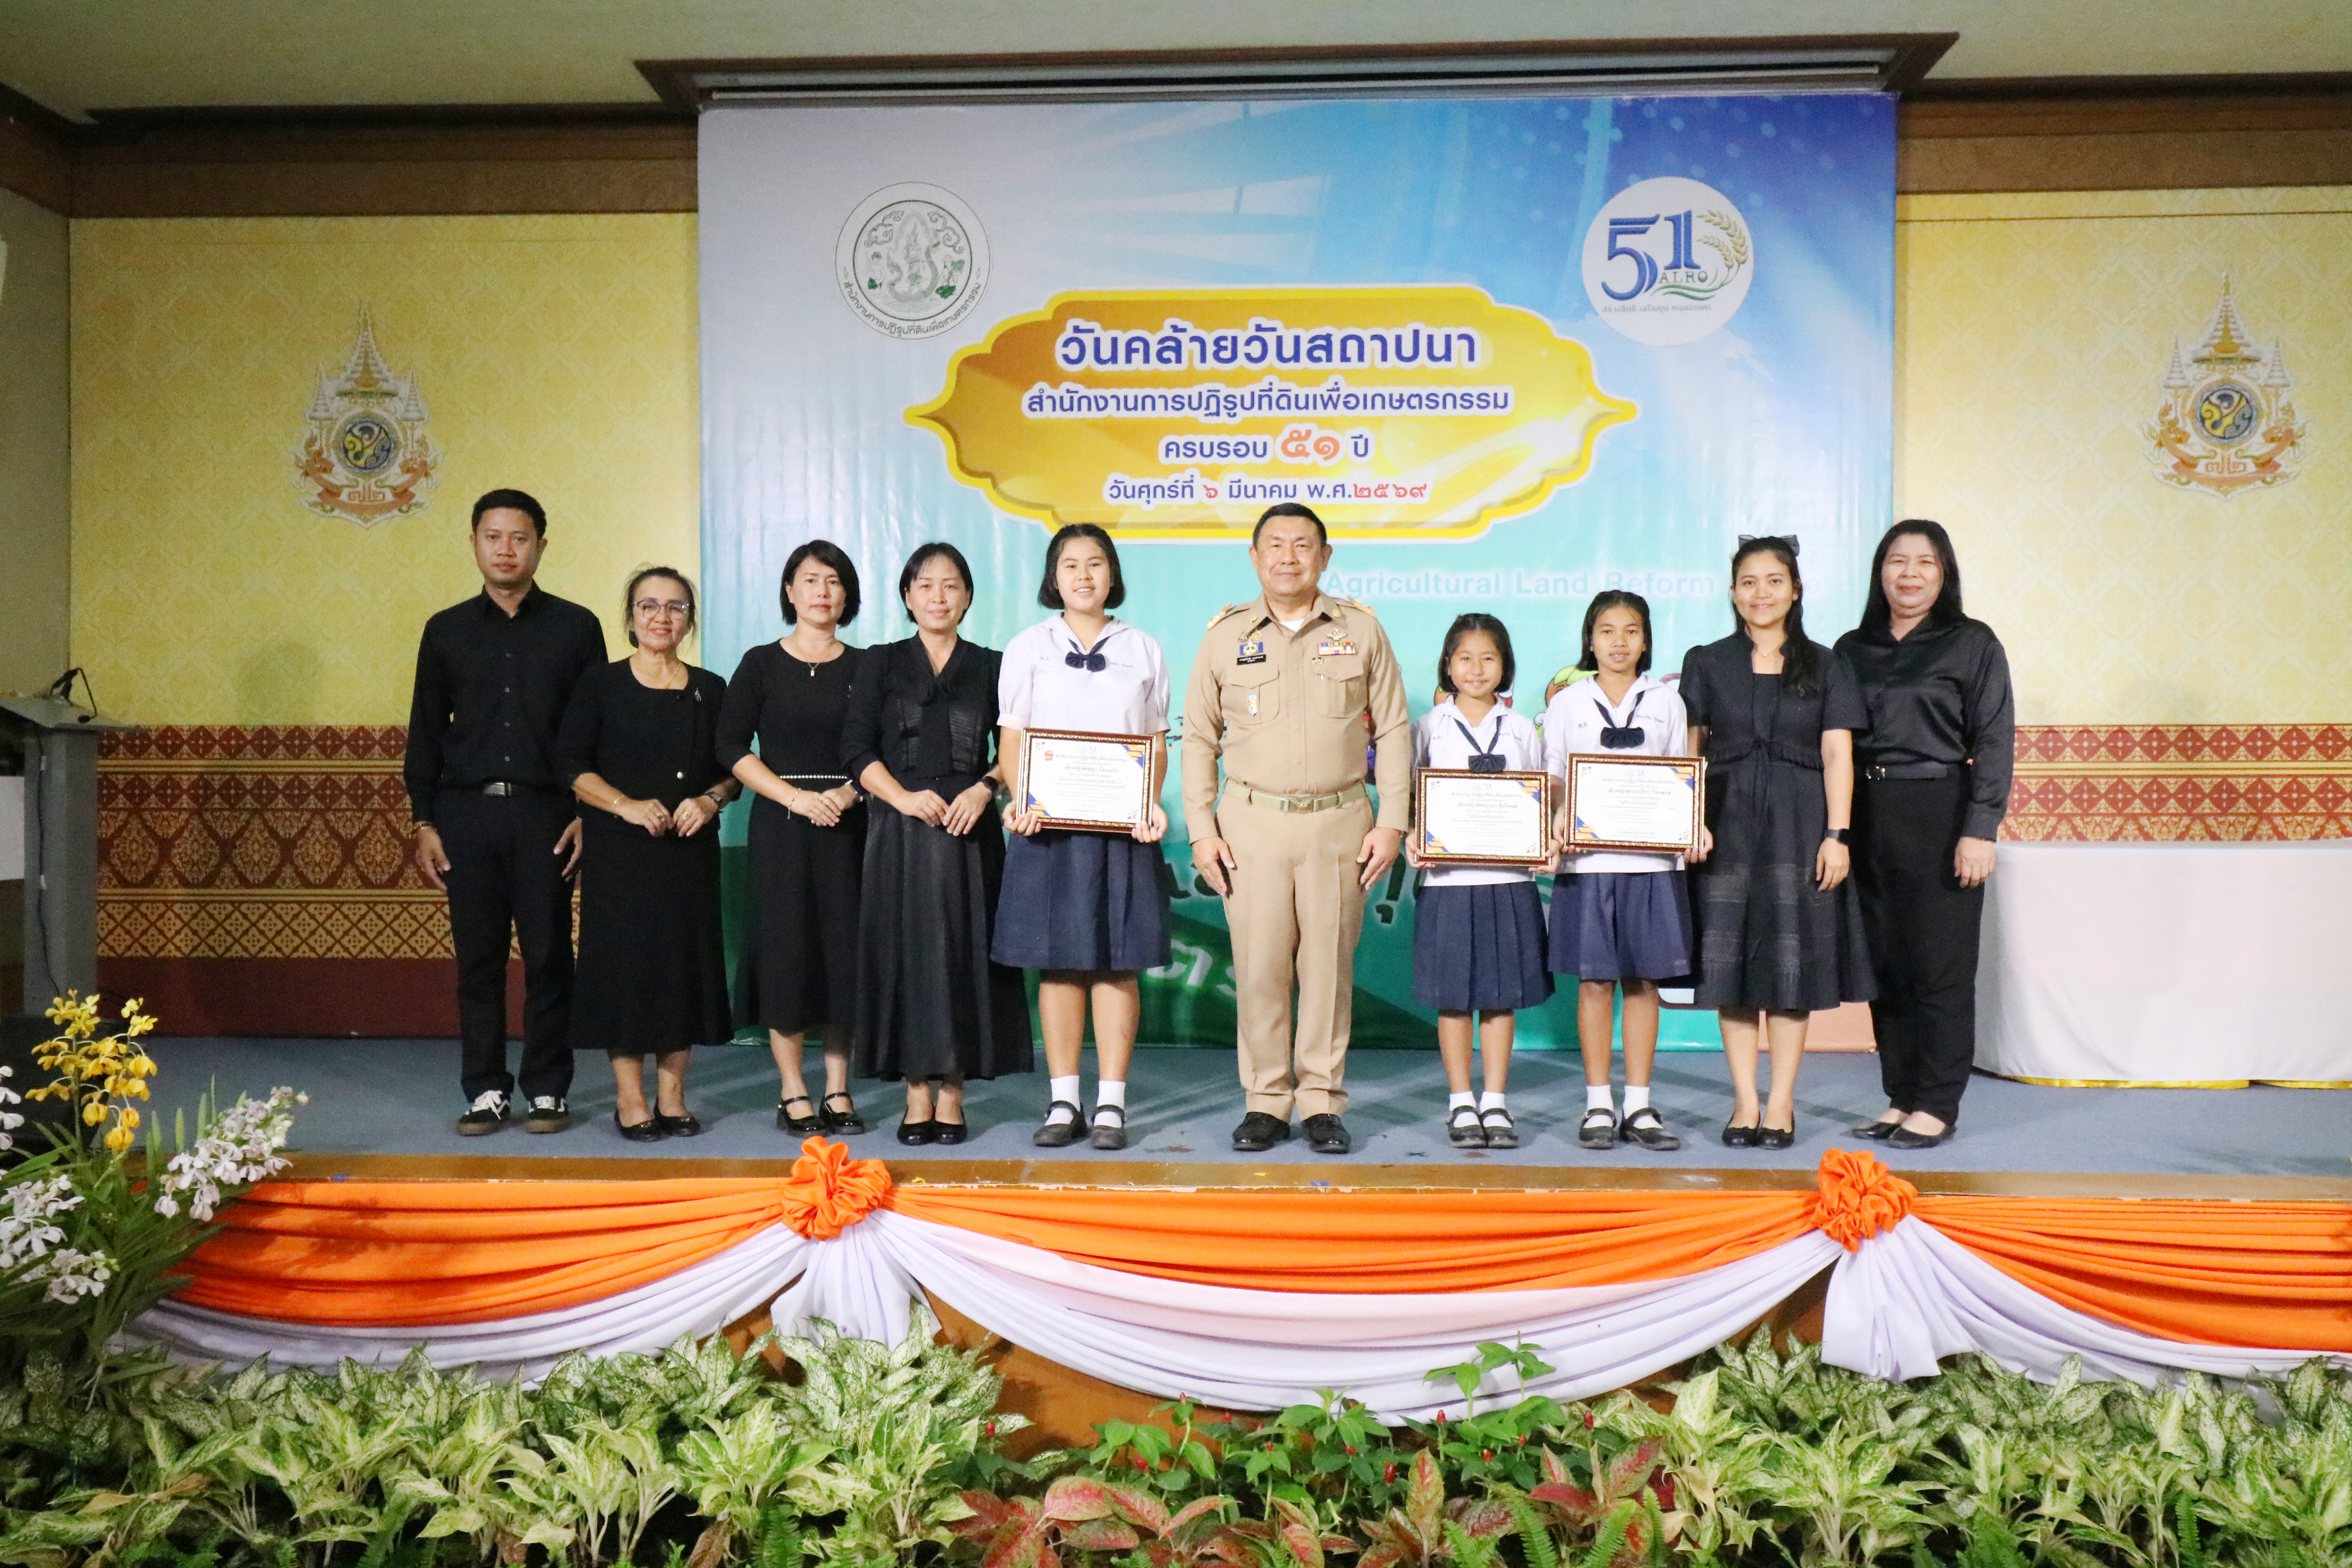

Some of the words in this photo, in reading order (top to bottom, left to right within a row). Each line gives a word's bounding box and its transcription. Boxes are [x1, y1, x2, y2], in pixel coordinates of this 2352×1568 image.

[1600, 209, 1701, 301] 51
[1659, 270, 1709, 285] ALRO
[1062, 322, 1476, 365] วันคล้ายวันสถาปนา
[1028, 381, 1509, 418] สำนักงานการปฏิรูปที่ดินเพื่อเกษตรกรรม
[1164, 440, 1268, 459] ครบรอบ
[1280, 428, 1340, 460] ๕๑
[1351, 433, 1369, 458] ปี
[1109, 474, 1194, 504] วันศุกร์ที่
[1203, 484, 1219, 499] ๖
[1229, 479, 1297, 499] มีนาคม
[1325, 571, 1500, 597] Agricultural
[1515, 571, 1589, 594] Land
[1604, 571, 1715, 594] Reform
